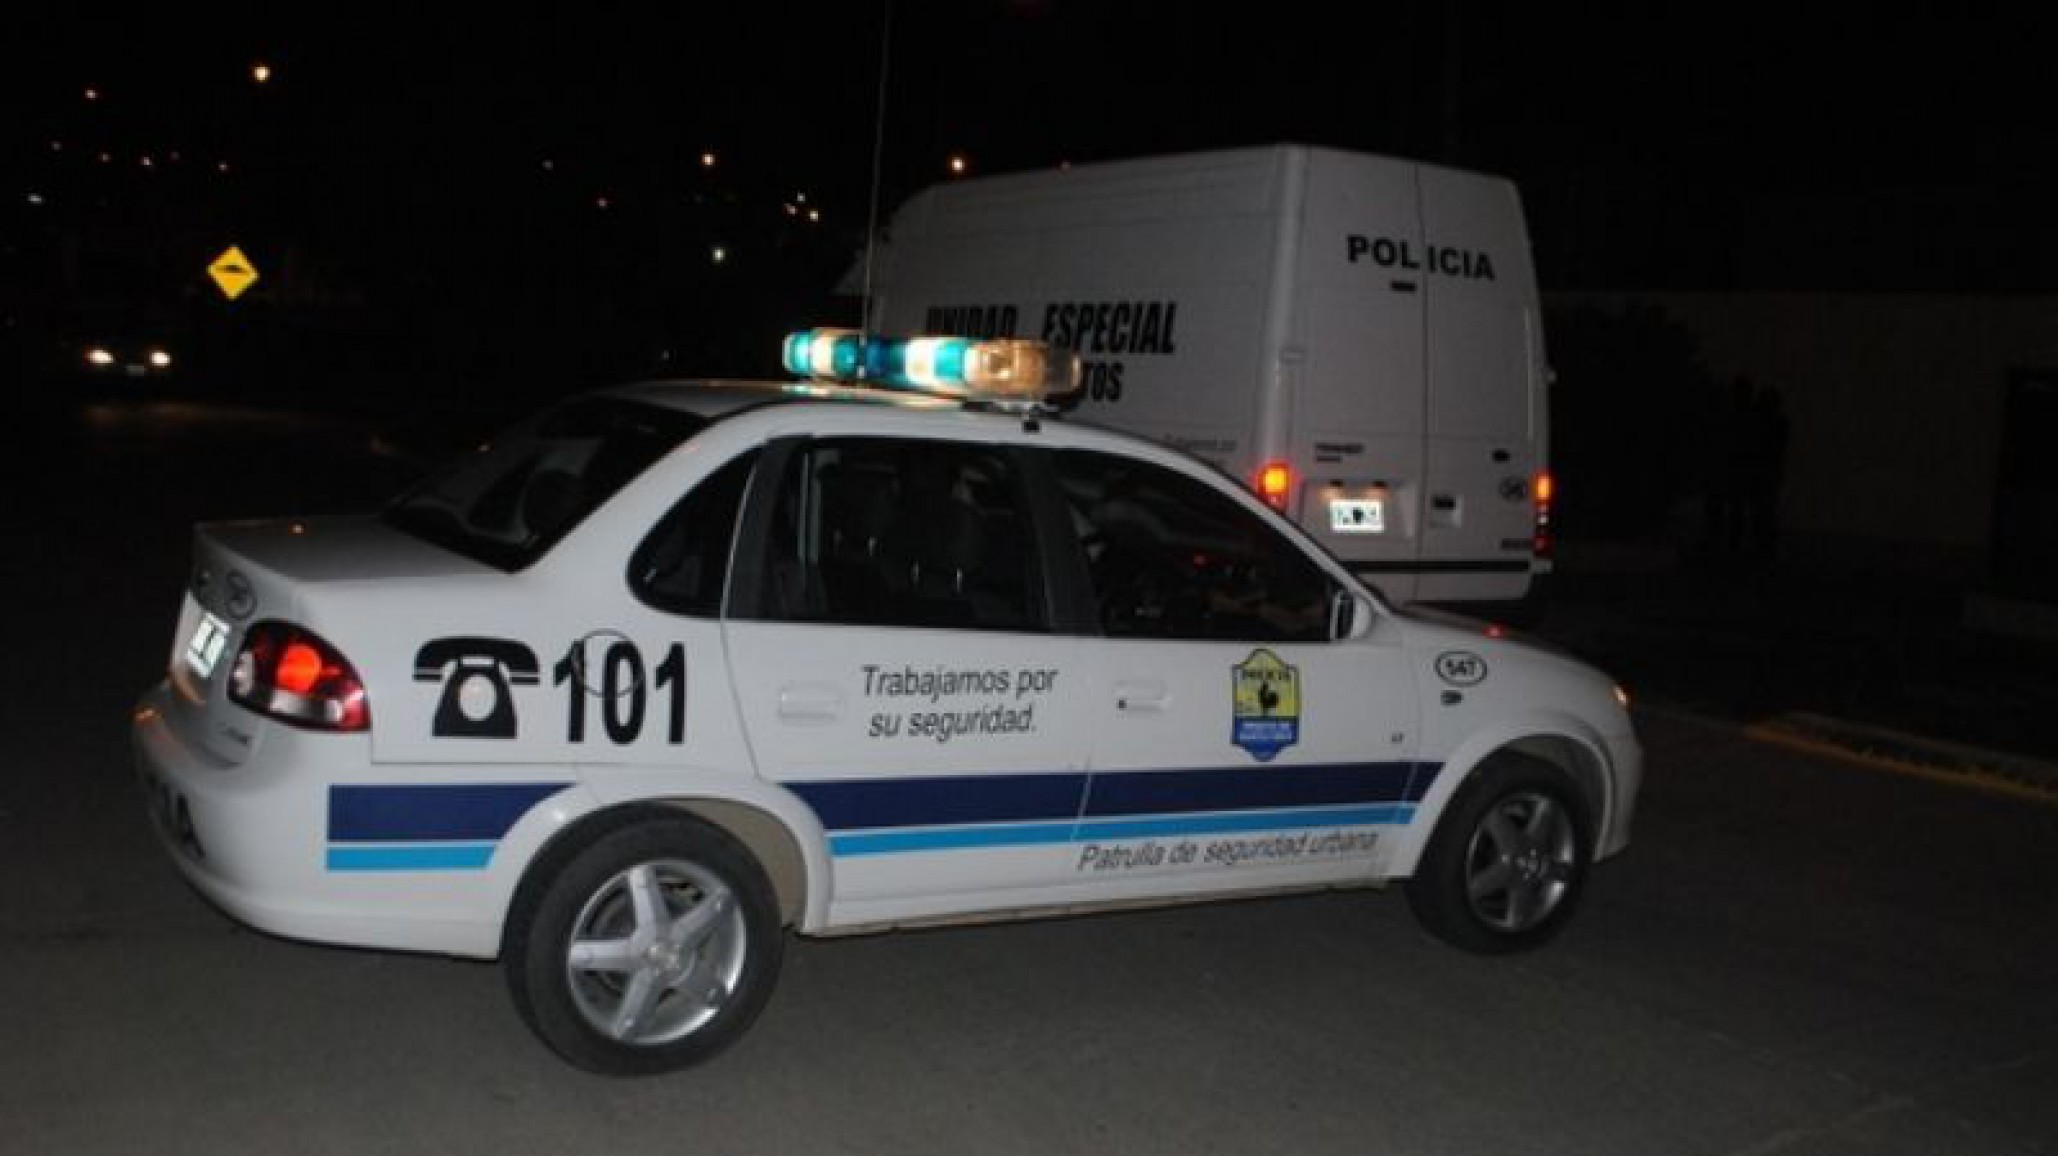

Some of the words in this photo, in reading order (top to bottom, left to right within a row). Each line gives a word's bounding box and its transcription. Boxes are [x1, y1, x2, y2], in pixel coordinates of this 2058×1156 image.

[1347, 234, 1496, 281] POLICIA
[1040, 301, 1177, 354] ESPECIAL
[553, 639, 685, 745] 101
[862, 664, 1009, 703] Trabajamos
[1015, 668, 1060, 700] por
[868, 712, 901, 737] su
[907, 703, 1037, 744] seguridad.
[1077, 840, 1165, 872] Patrulla
[1168, 841, 1197, 864] de
[1203, 830, 1308, 866] seguridad
[1309, 827, 1380, 857] urbana
